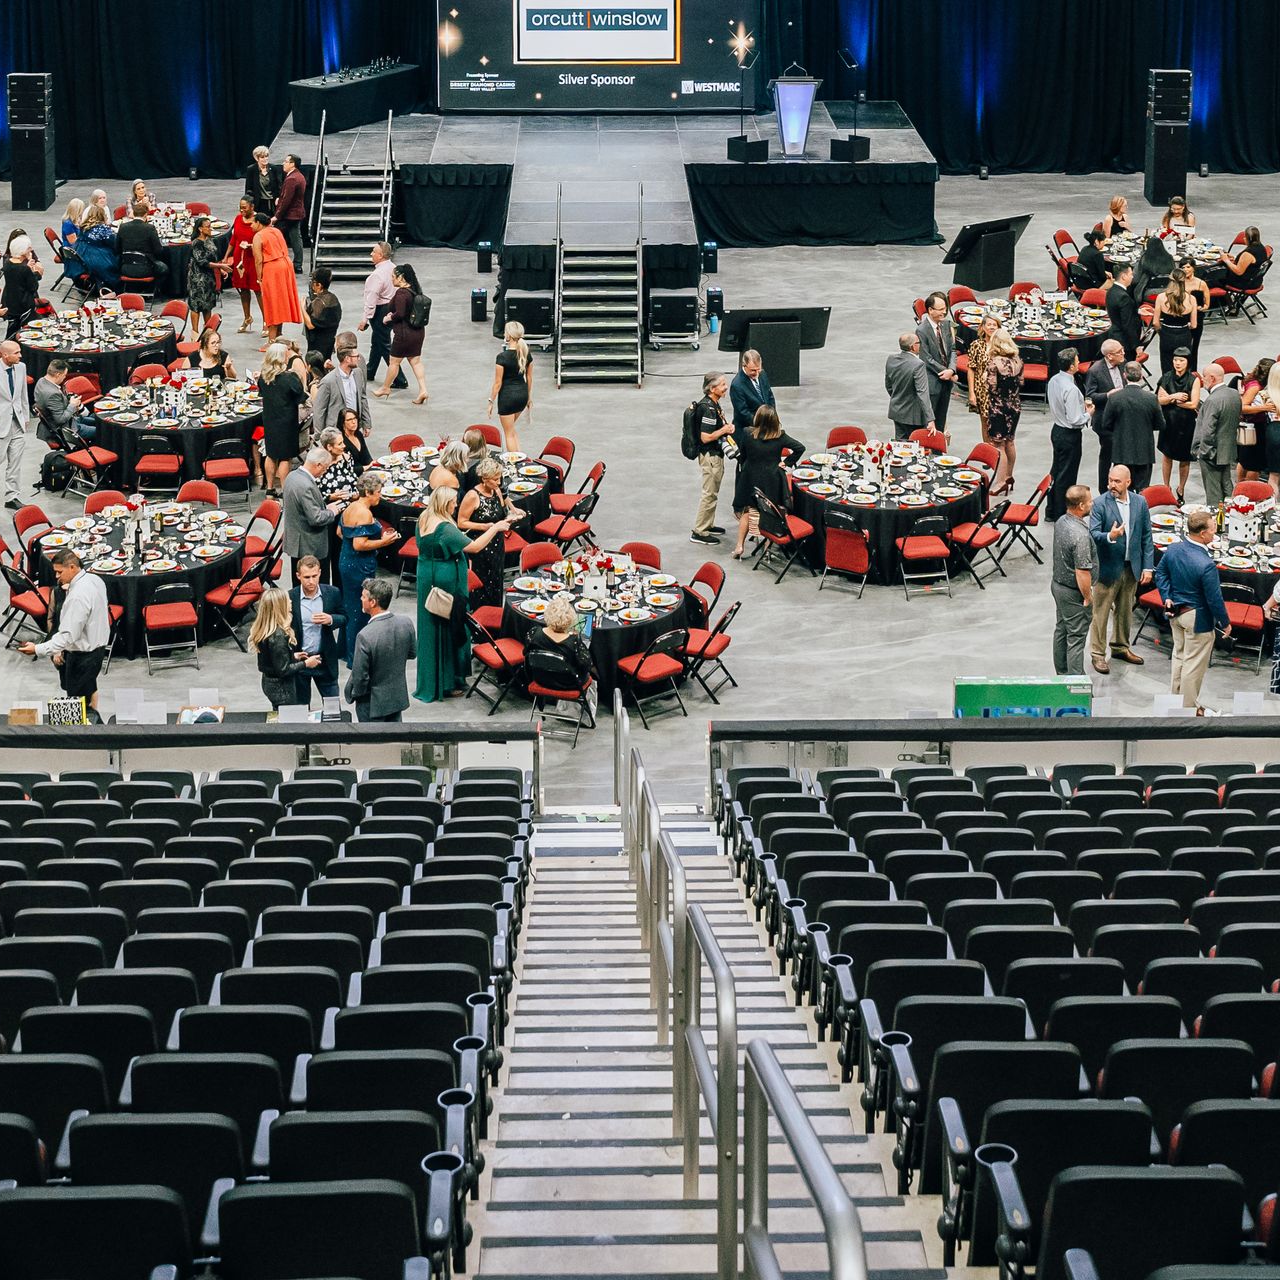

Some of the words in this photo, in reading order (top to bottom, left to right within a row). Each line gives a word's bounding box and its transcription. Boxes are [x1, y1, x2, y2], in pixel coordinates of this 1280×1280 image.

[532, 11, 584, 26] orcutt
[592, 10, 663, 26] winslow
[558, 74, 588, 85] Silver
[591, 74, 635, 87] Sponsor
[694, 83, 741, 92] WESTMARC
